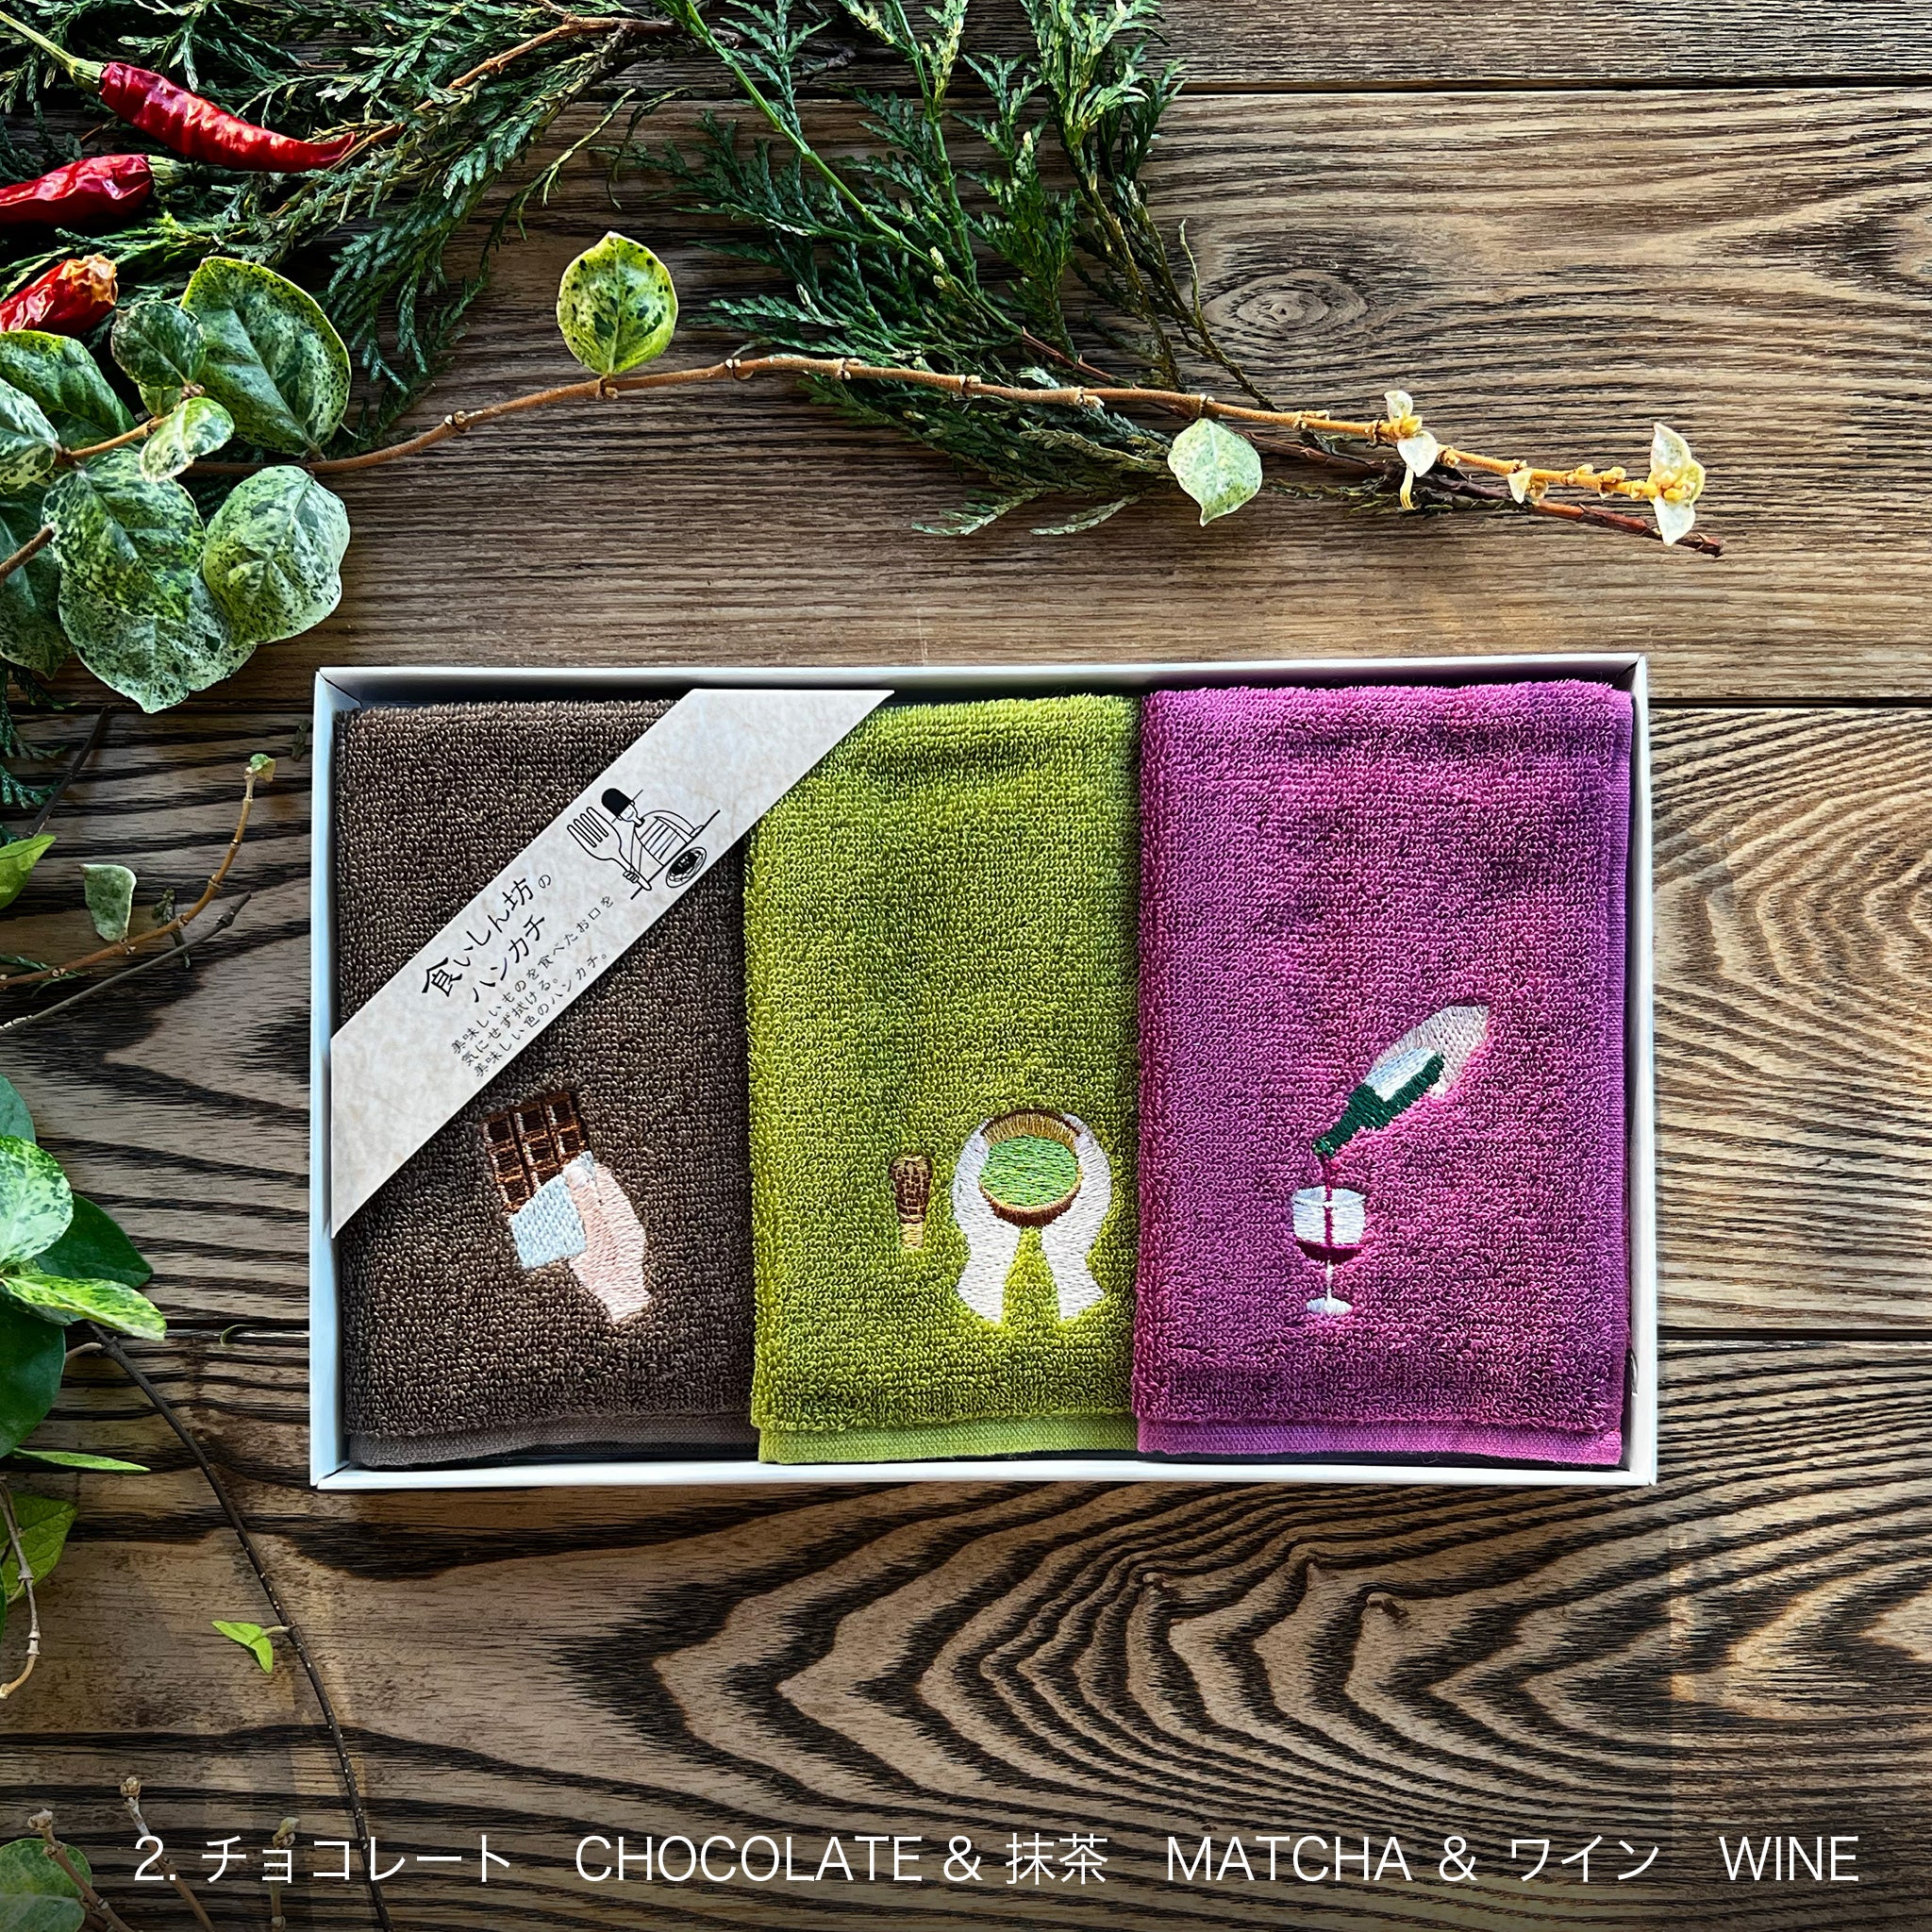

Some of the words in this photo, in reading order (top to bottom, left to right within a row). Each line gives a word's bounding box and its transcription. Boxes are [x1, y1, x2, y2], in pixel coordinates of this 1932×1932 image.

[421, 874, 552, 997] 食いしん坊の
[450, 895, 614, 1054] 美味しいものを食べたお口を
[472, 913, 545, 1003] ハンカチ
[460, 977, 559, 1069] 気にせず拭ける。
[474, 953, 608, 1077] 美味しい色のハンカチ。
